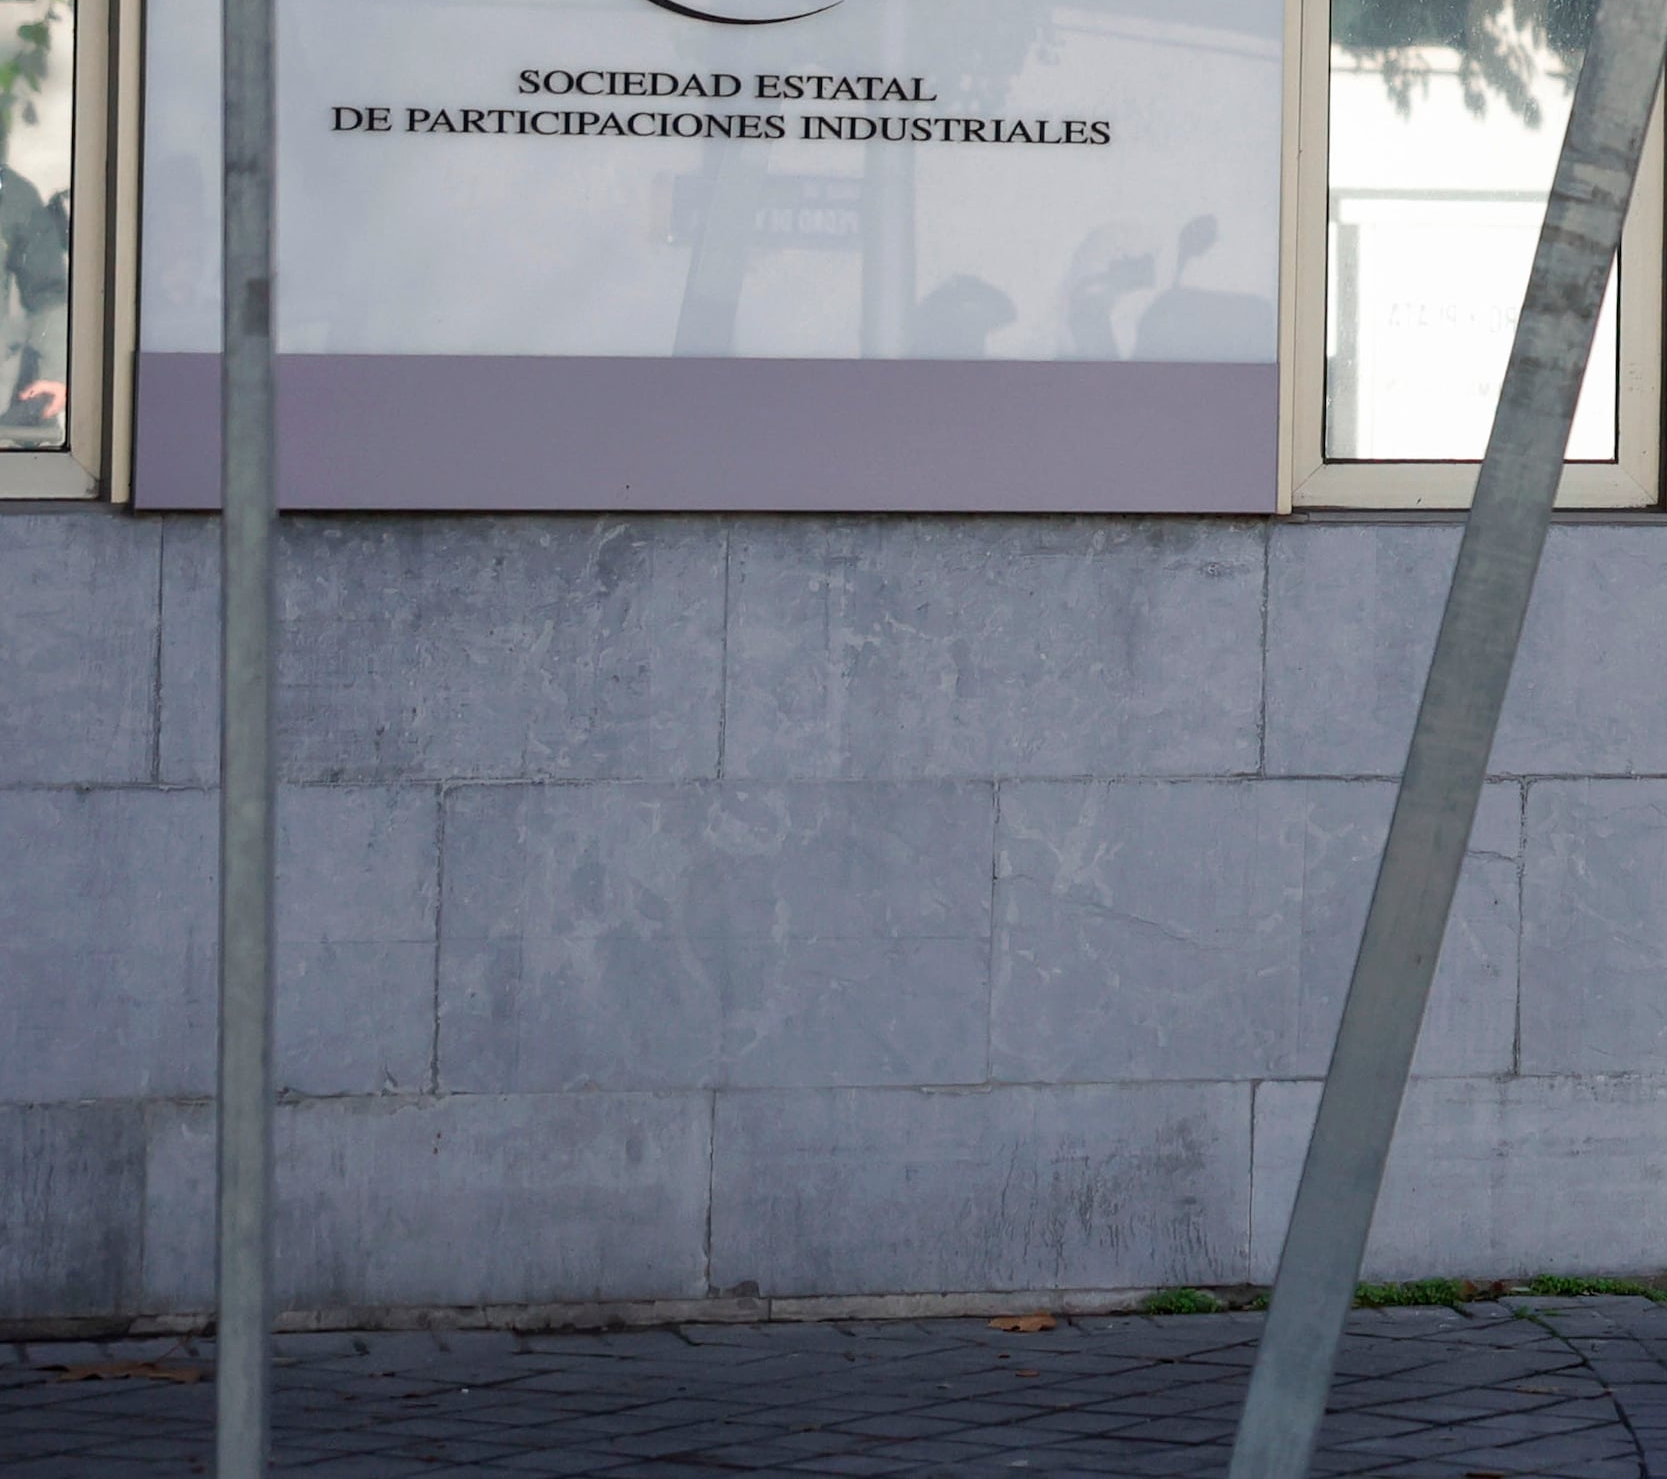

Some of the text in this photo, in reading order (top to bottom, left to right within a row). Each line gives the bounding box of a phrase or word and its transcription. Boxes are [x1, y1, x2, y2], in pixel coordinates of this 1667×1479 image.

[518, 69, 937, 103] SOCIEDAD ESTATAL
[332, 106, 1112, 146] DE PARTICIPACIONES INDUSTRIALES
